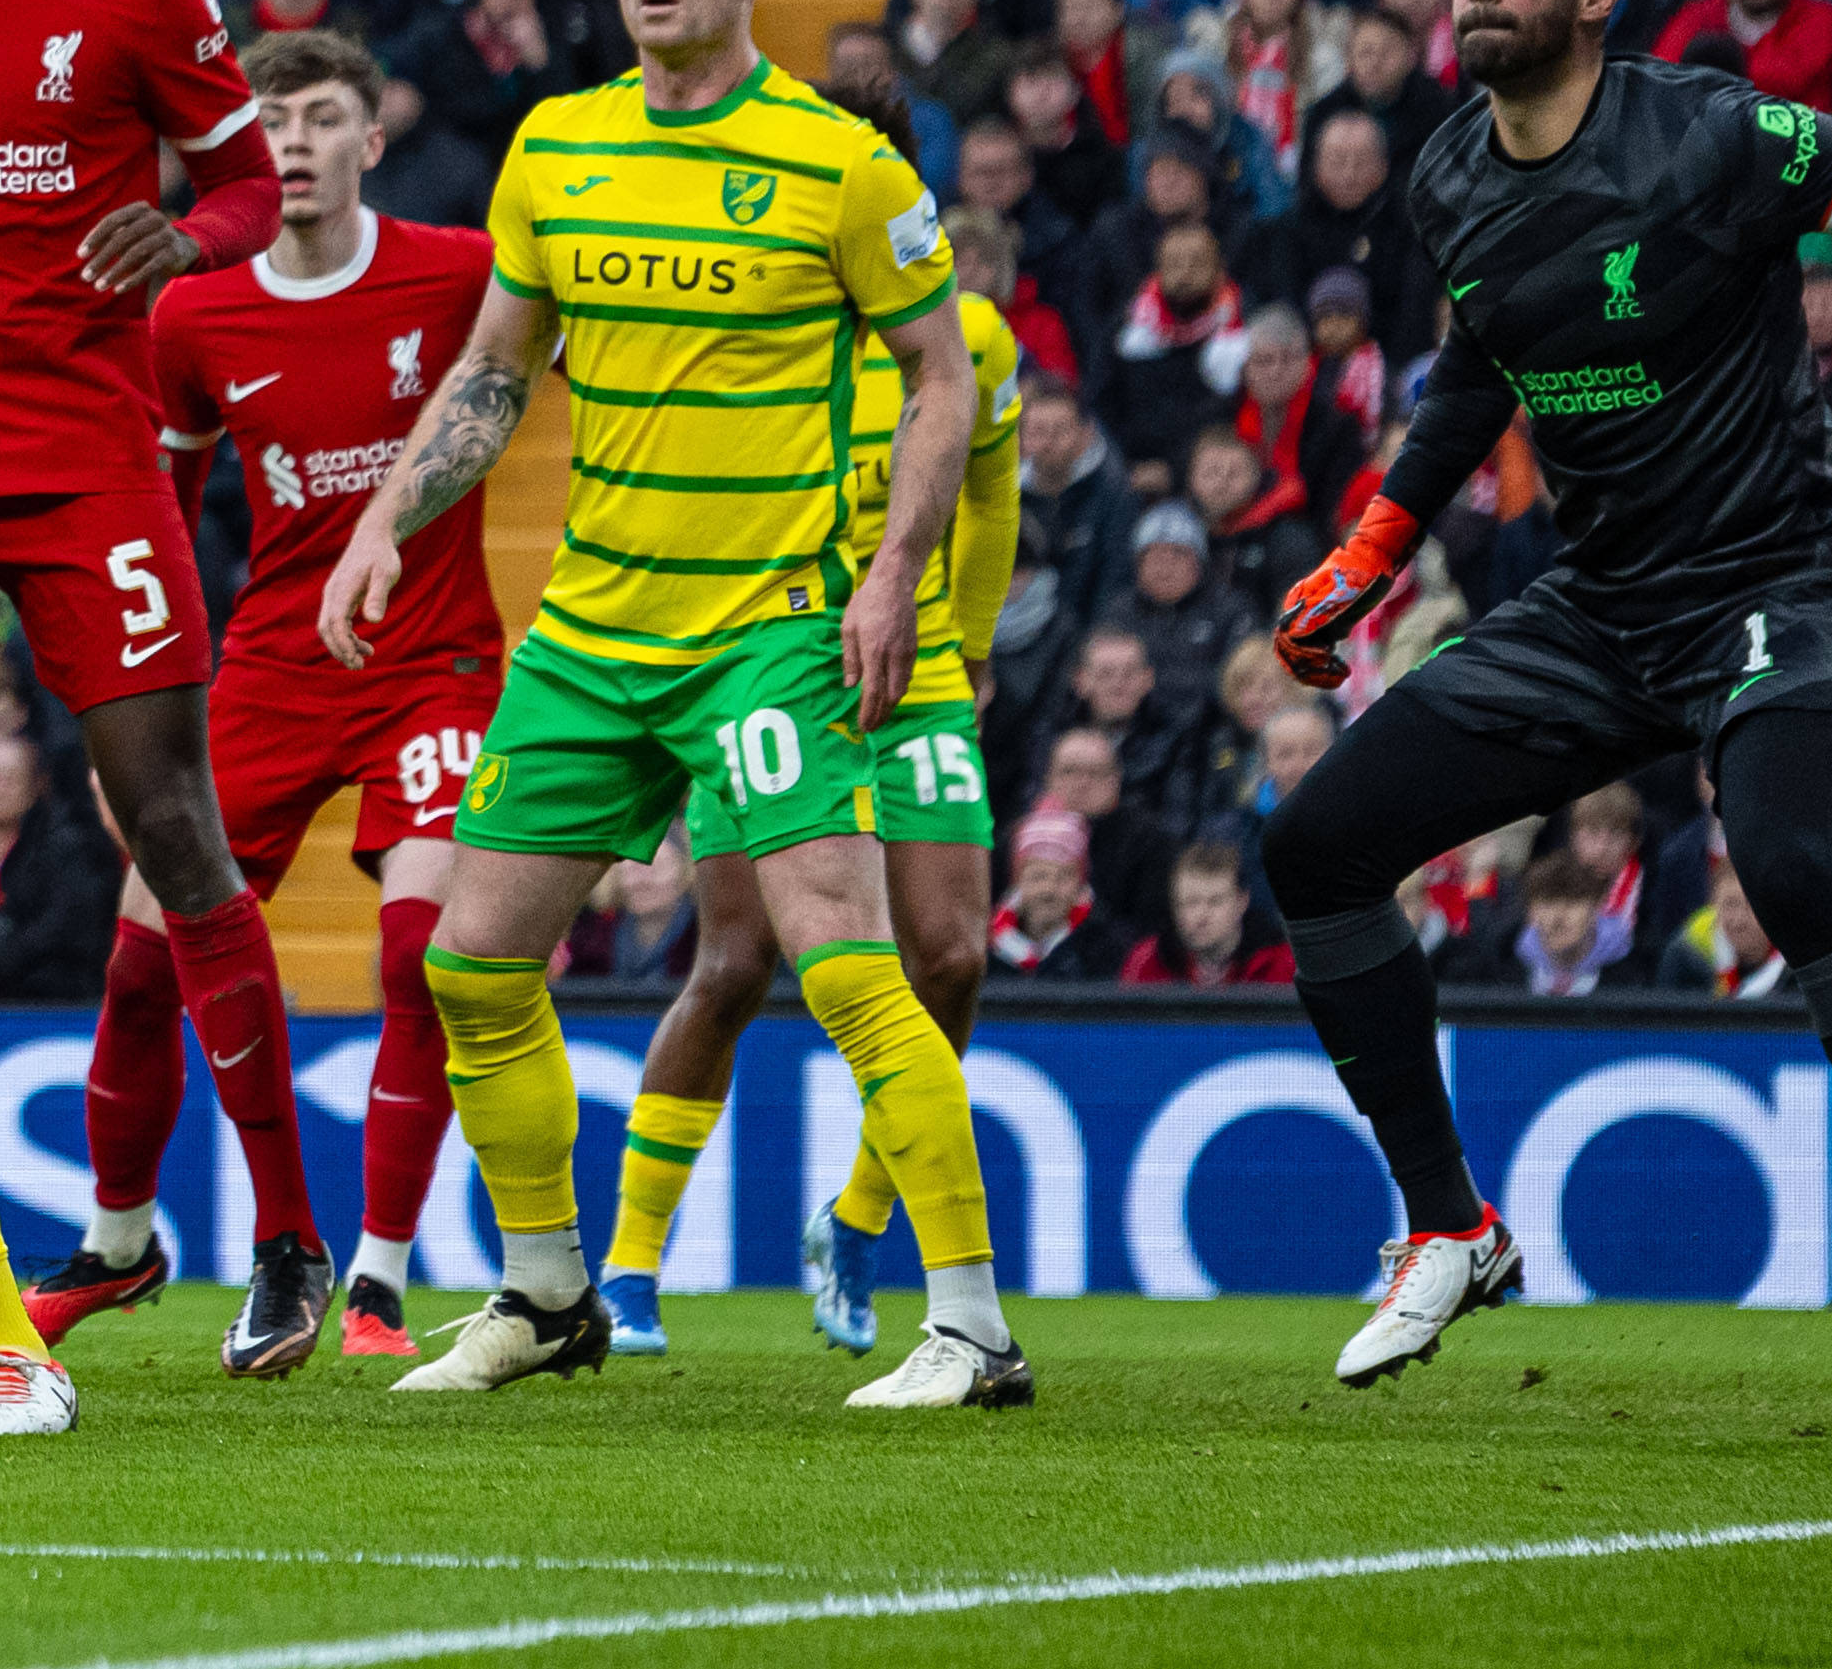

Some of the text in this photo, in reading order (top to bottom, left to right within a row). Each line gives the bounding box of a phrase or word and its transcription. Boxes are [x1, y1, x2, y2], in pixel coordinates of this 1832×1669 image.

[572, 247, 737, 294] LOTUS
[1521, 361, 1646, 392] standard
[1531, 380, 1663, 415] chartered
[303, 437, 407, 477] standa
[107, 537, 171, 635] 5
[1742, 612, 1775, 674] 1
[716, 707, 803, 809] 10
[895, 733, 984, 805] 15
